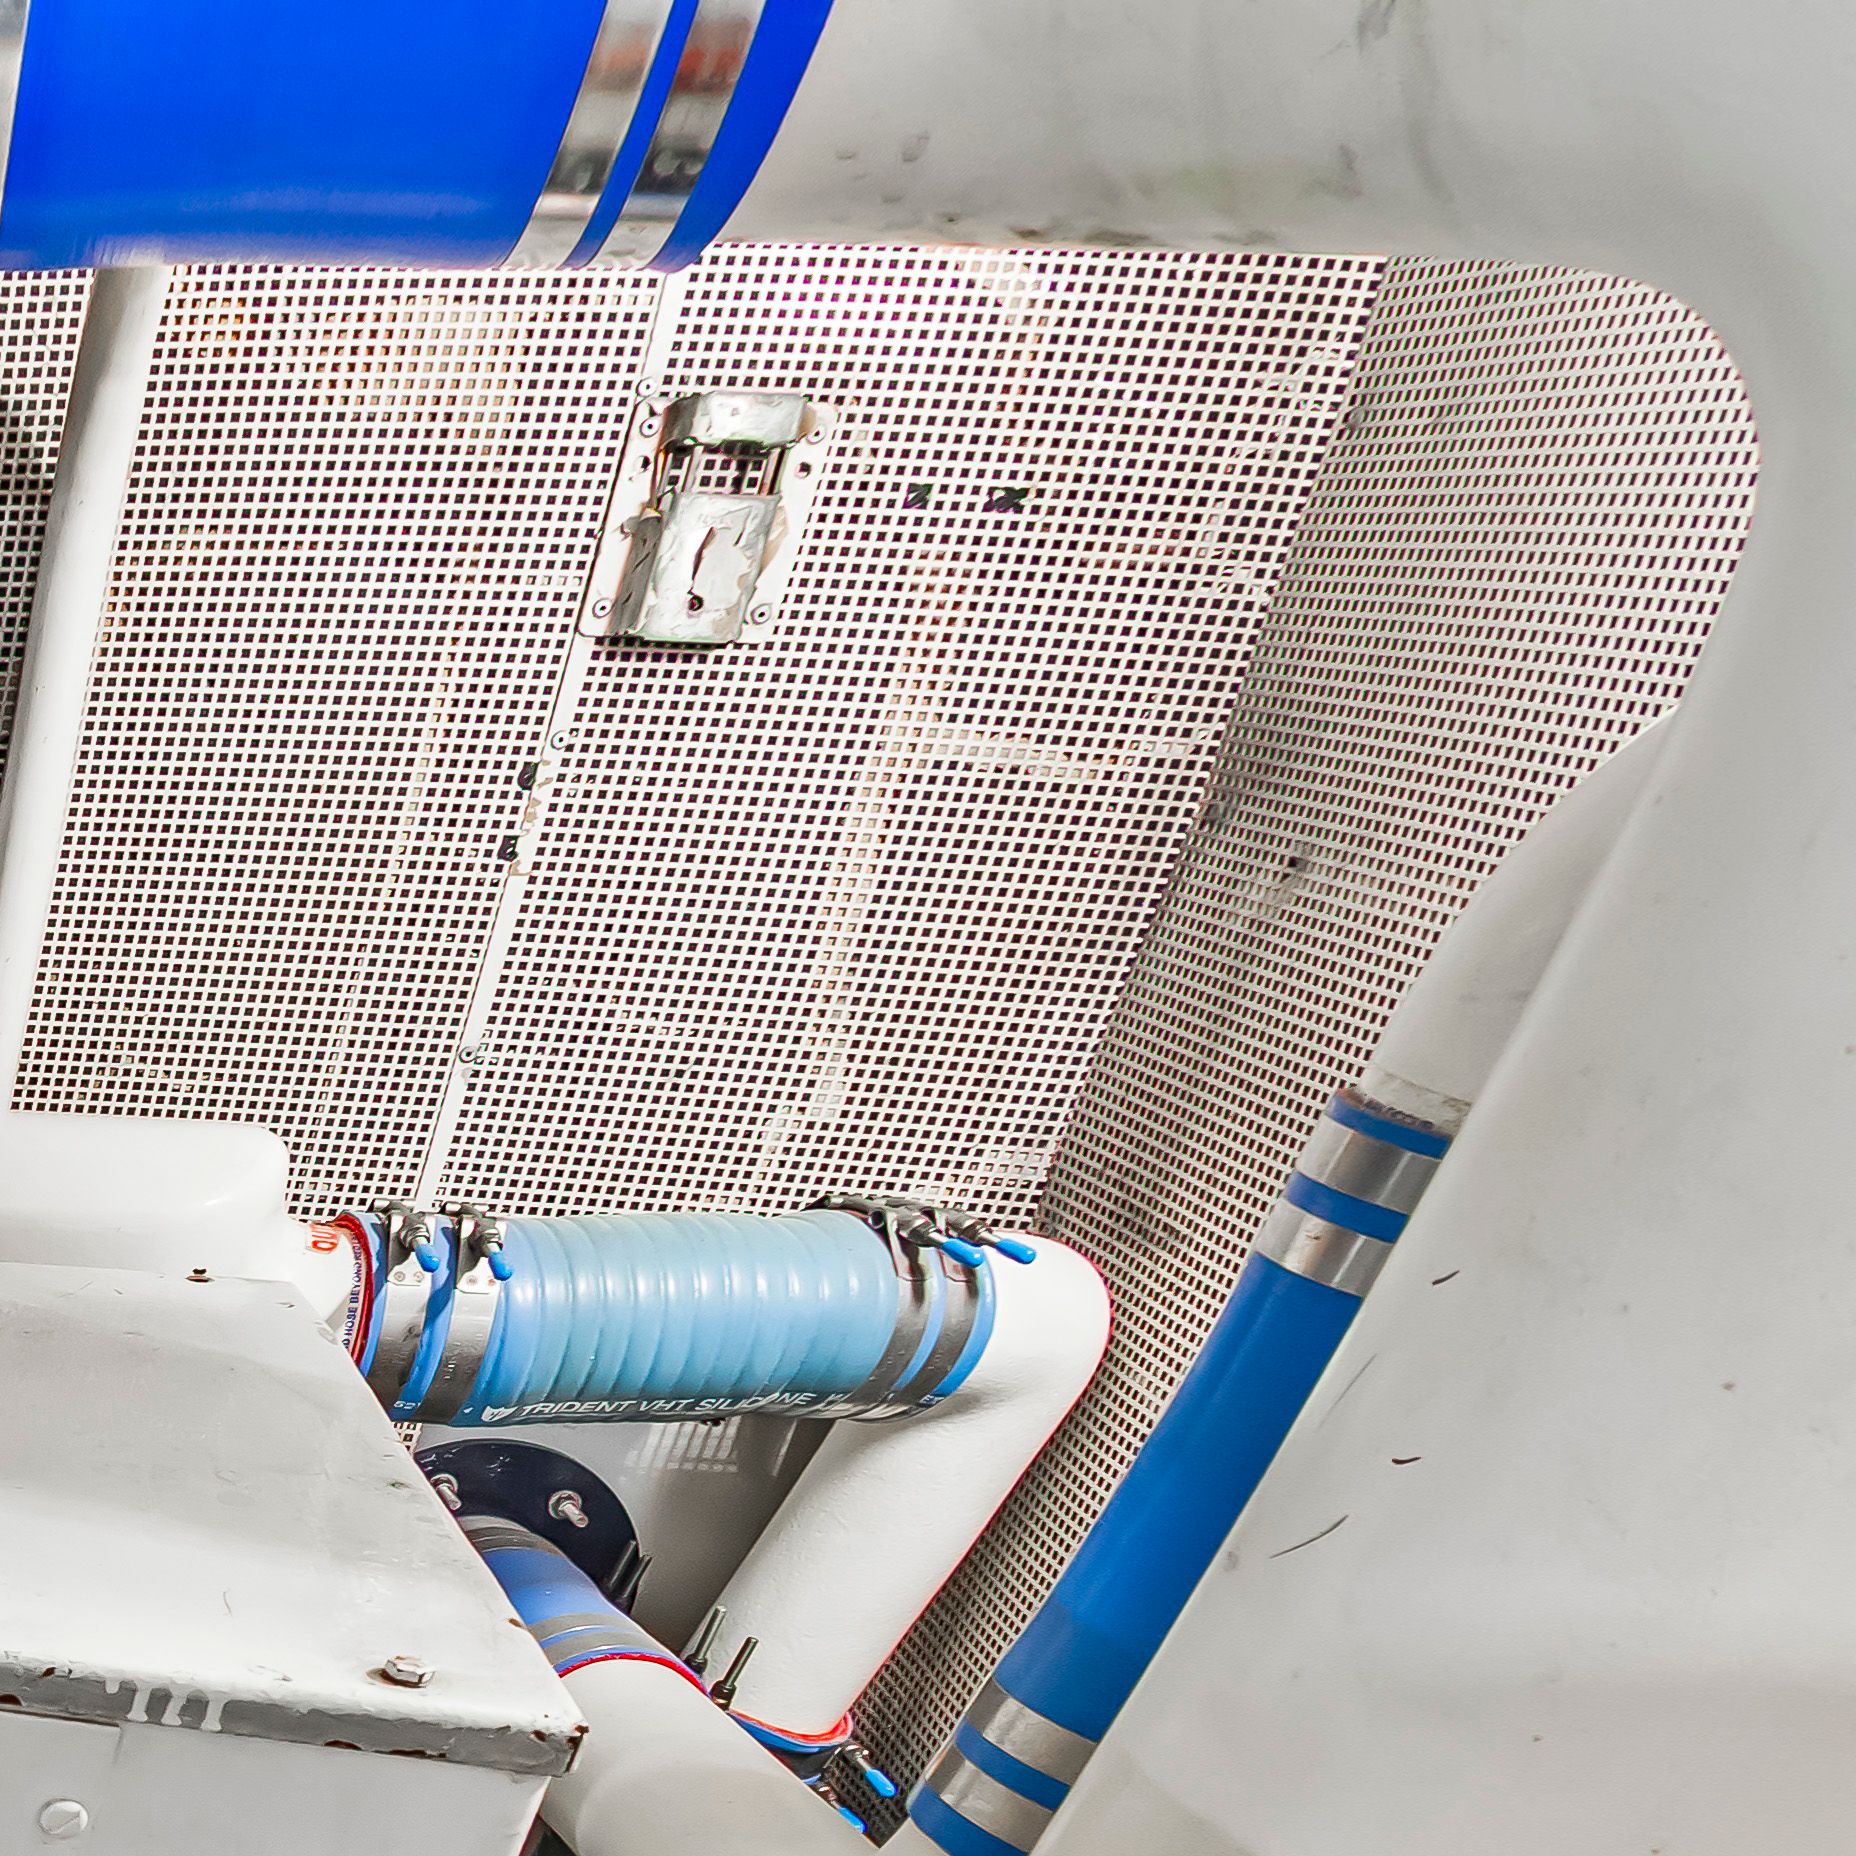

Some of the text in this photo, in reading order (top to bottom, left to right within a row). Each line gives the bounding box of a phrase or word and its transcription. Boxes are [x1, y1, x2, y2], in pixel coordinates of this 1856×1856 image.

[520, 1400, 638, 1417] TRIDENT
[638, 1398, 696, 1413] VHT
[694, 1392, 818, 1411] SILICONE
